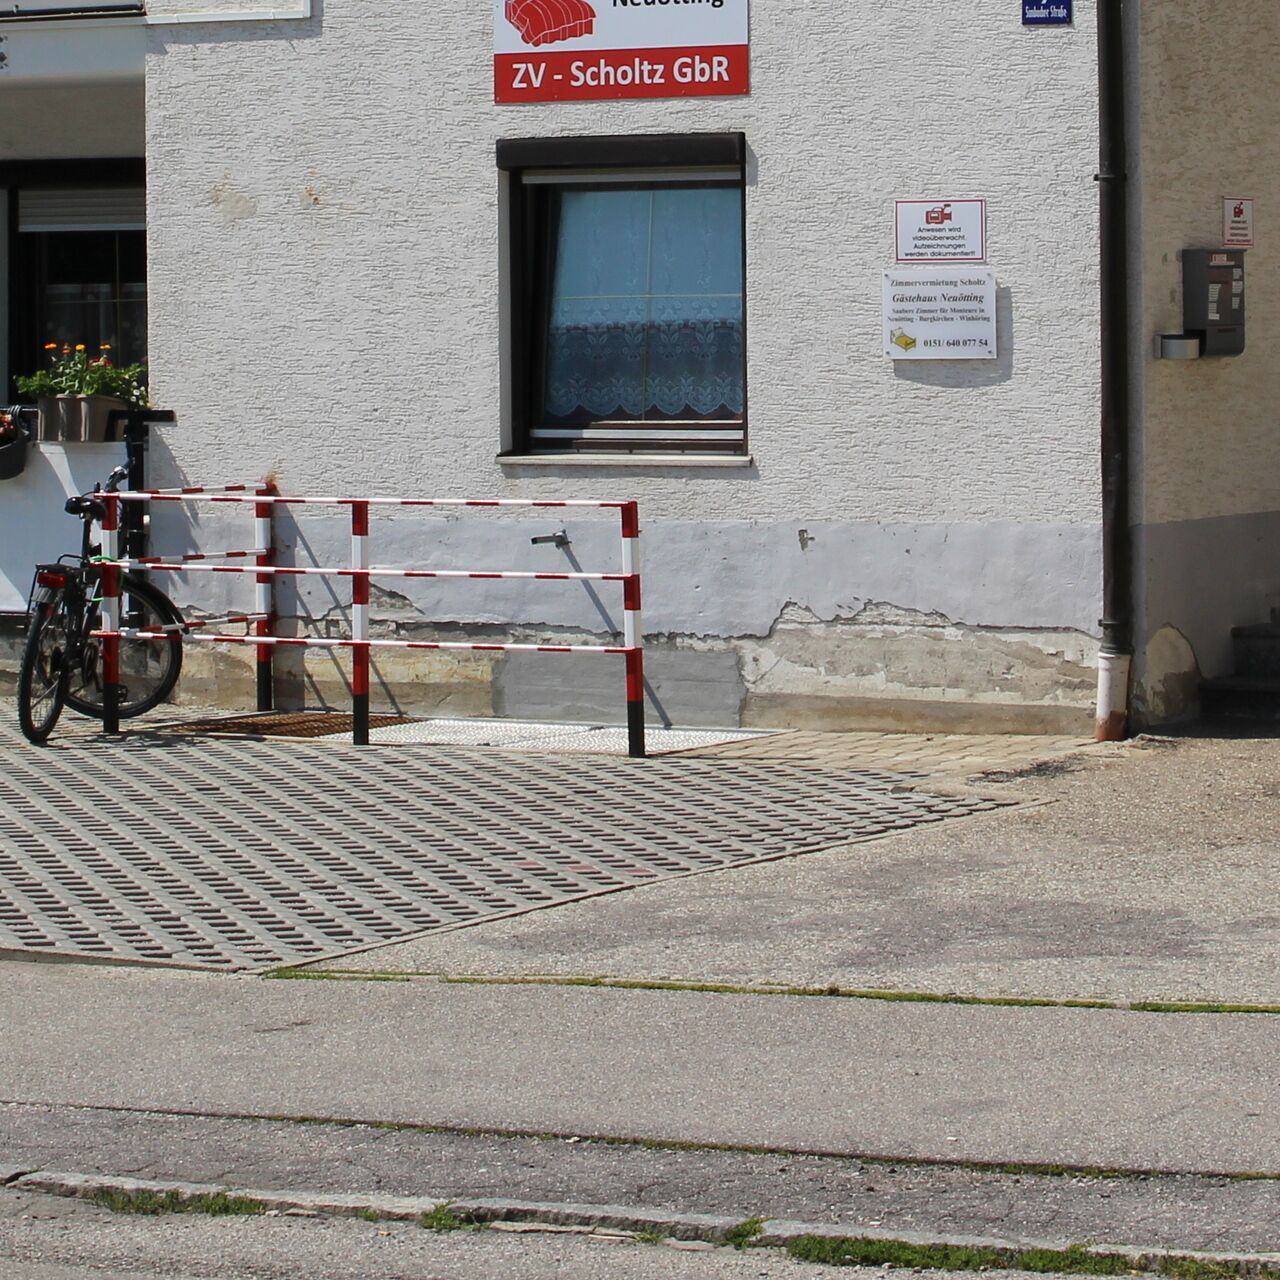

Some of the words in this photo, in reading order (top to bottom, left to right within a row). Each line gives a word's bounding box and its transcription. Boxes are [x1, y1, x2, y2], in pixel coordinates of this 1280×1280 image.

[511, 62, 546, 89] ZV
[570, 57, 665, 87] Scholtz
[673, 55, 730, 83] GbR
[890, 278, 958, 288] Zimmervermietung
[960, 278, 986, 286] Scholtz
[892, 293, 938, 303] Gästehaus
[941, 292, 985, 304] Neuötting
[923, 338, 944, 347] 0151/
[946, 338, 960, 347] 640
[962, 338, 976, 347] 077
[978, 337, 988, 346] 54
